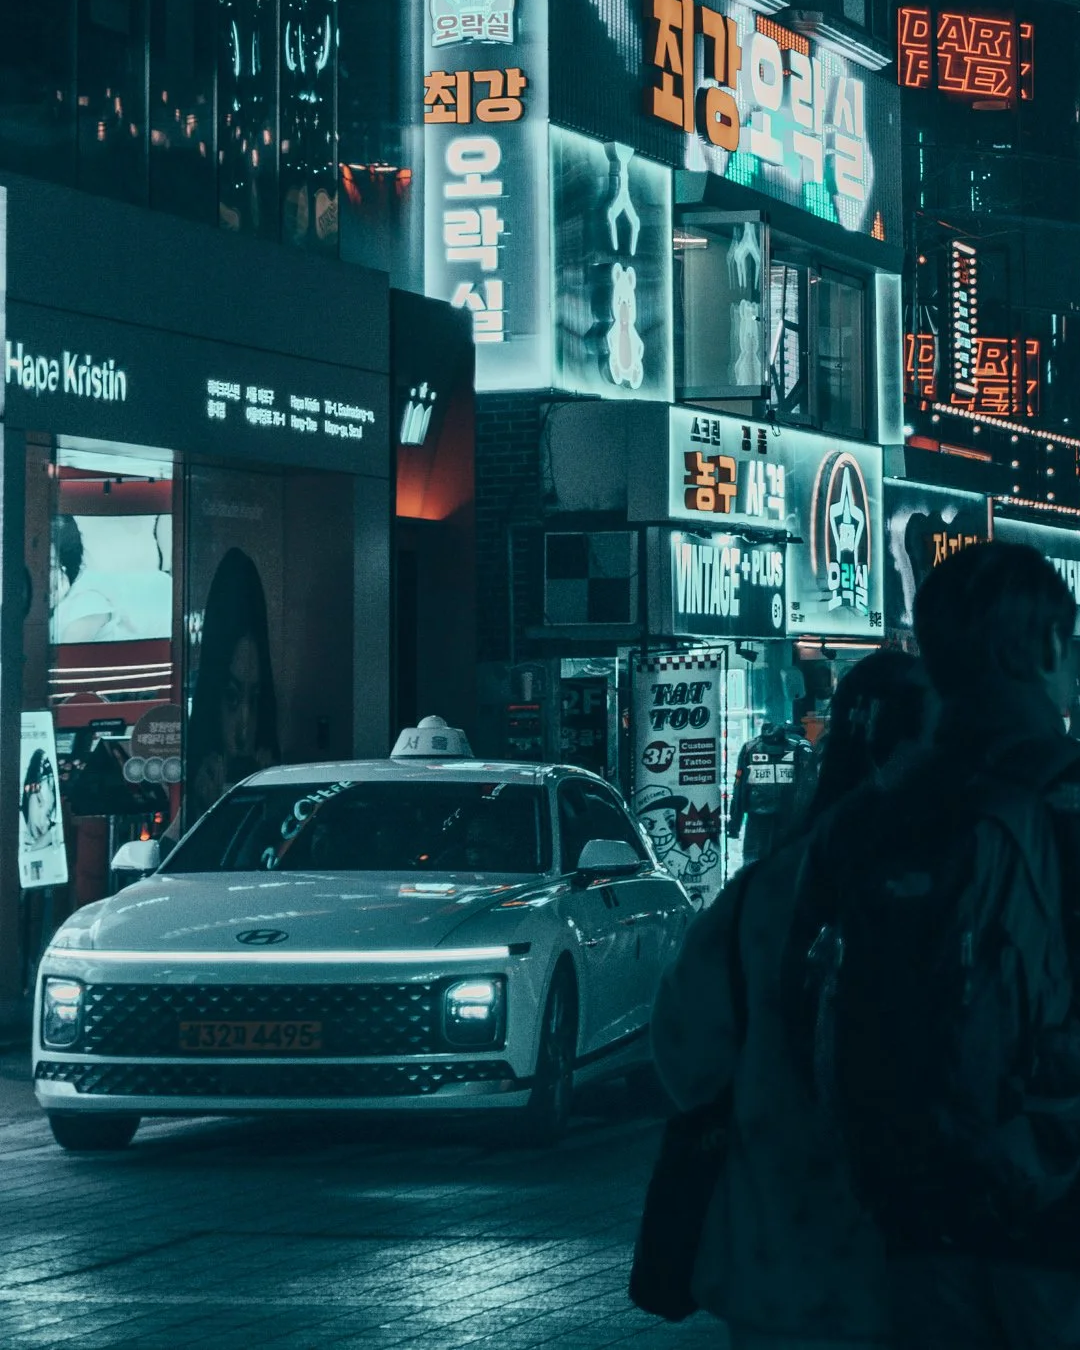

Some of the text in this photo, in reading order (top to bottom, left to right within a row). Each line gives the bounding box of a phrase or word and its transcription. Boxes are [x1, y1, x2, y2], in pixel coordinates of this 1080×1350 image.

[436, 12, 509, 41] 오락실
[424, 68, 527, 124] 최강
[751, 33, 867, 200] 오락실
[443, 137, 506, 343] 오락실
[5, 340, 127, 401] Hapa Kristin
[690, 417, 721, 446] 스크린
[745, 460, 785, 521] 사격
[675, 540, 741, 618] VINTAGE
[828, 562, 868, 616] 오락실
[650, 681, 712, 706] TAT
[649, 706, 710, 731] TOO
[402, 736, 448, 751] 서울
[643, 746, 675, 765] 3F
[682, 742, 714, 750] Custom
[684, 757, 712, 767] Tattoo
[683, 773, 713, 784] Design
